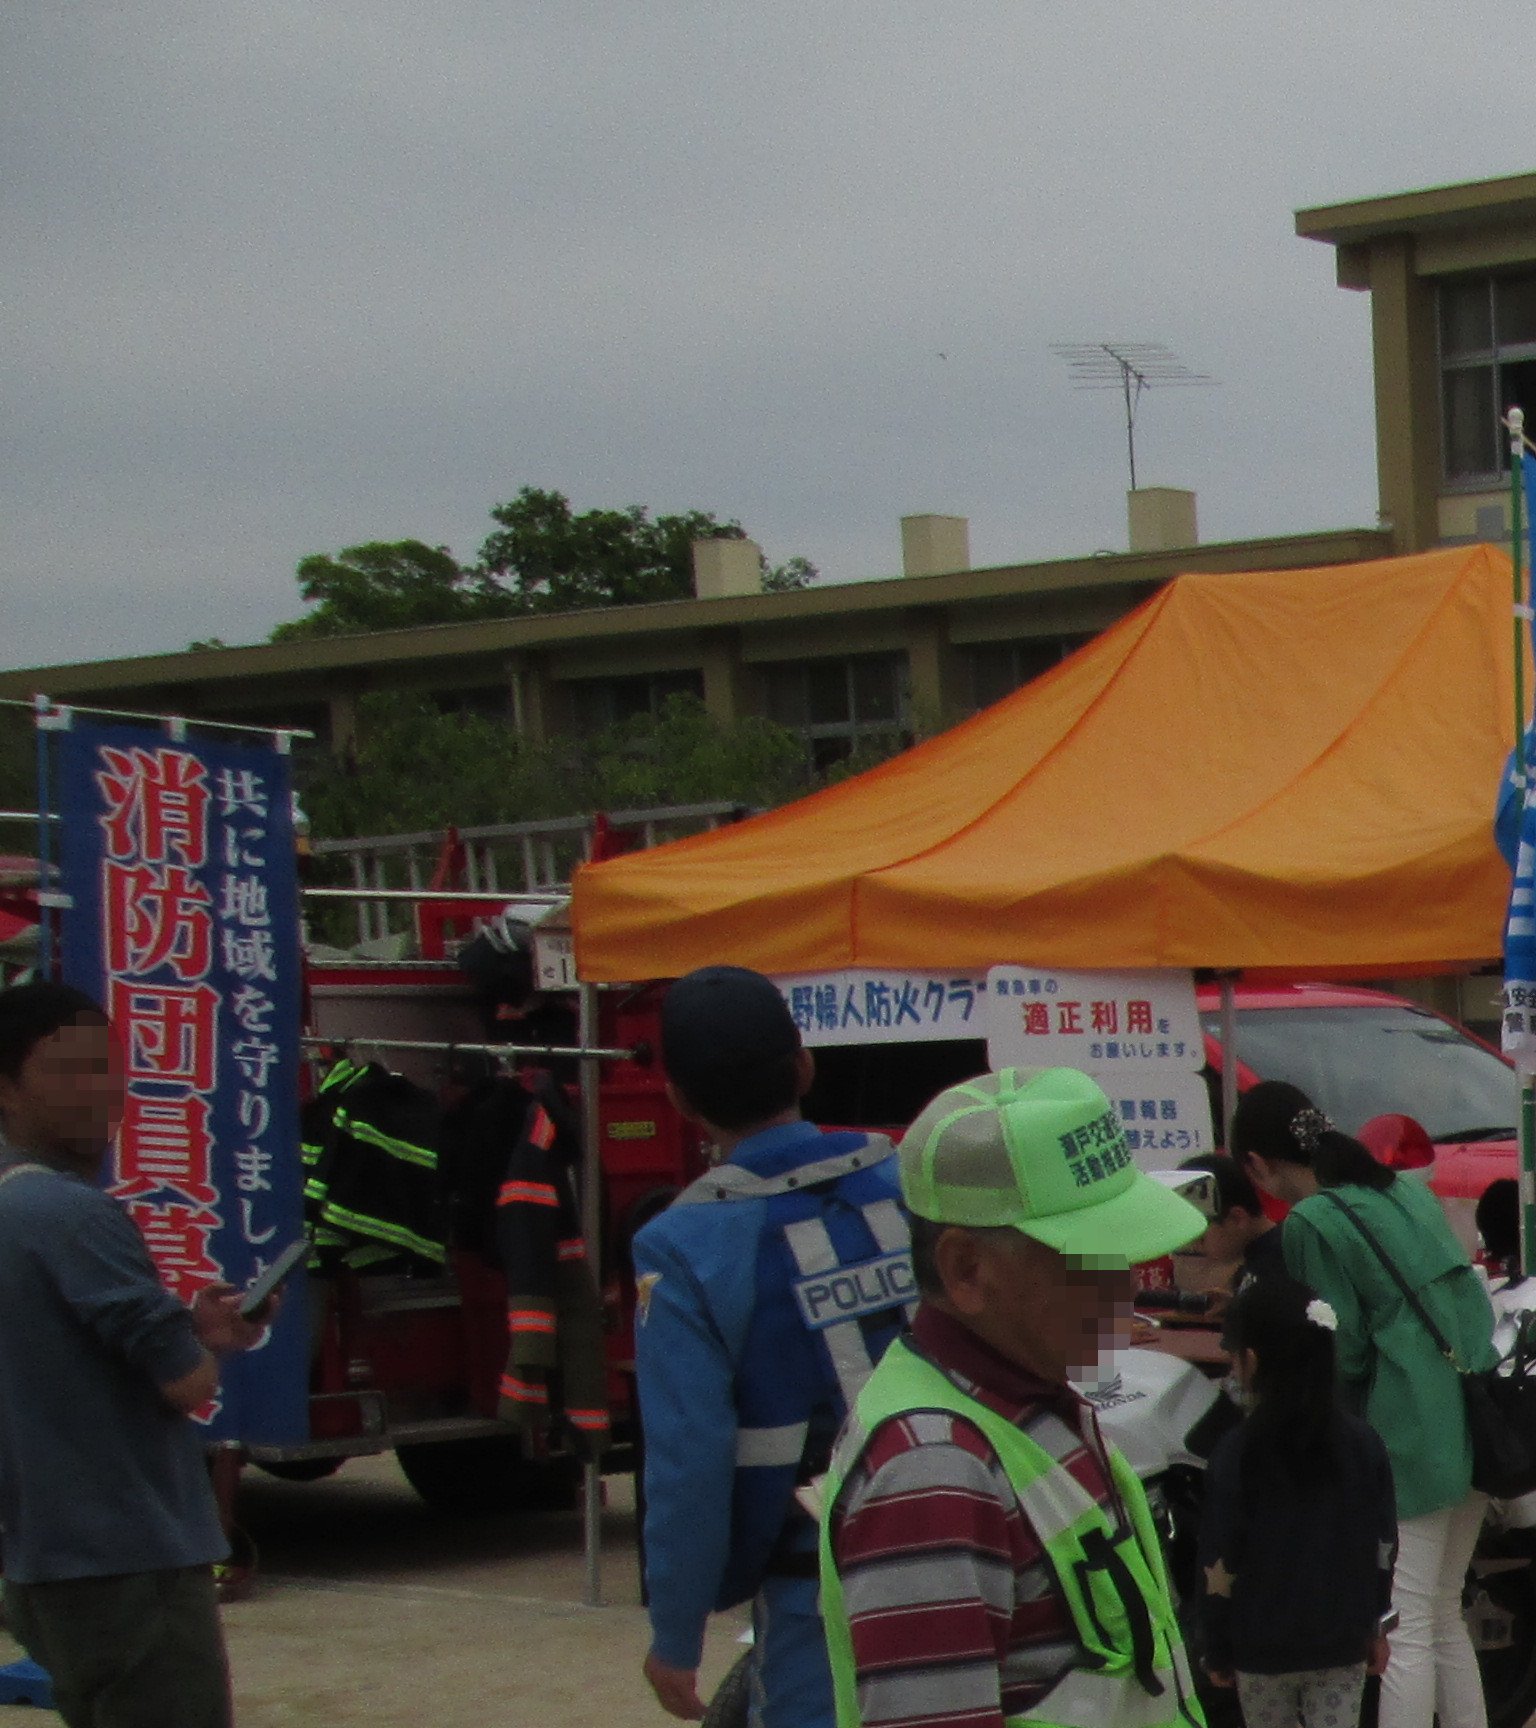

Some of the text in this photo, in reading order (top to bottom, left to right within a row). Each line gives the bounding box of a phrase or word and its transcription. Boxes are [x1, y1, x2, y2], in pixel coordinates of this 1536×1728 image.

[791, 980, 987, 1030] 野婦人防火クラ
[1022, 1000, 1170, 1035] 適正利用を
[96, 746, 225, 1426] 消防団員募
[217, 768, 280, 1351] 共に地域を守りまし
[1112, 1099, 1177, 1120] 警報器
[804, 1262, 916, 1318] POLIC
